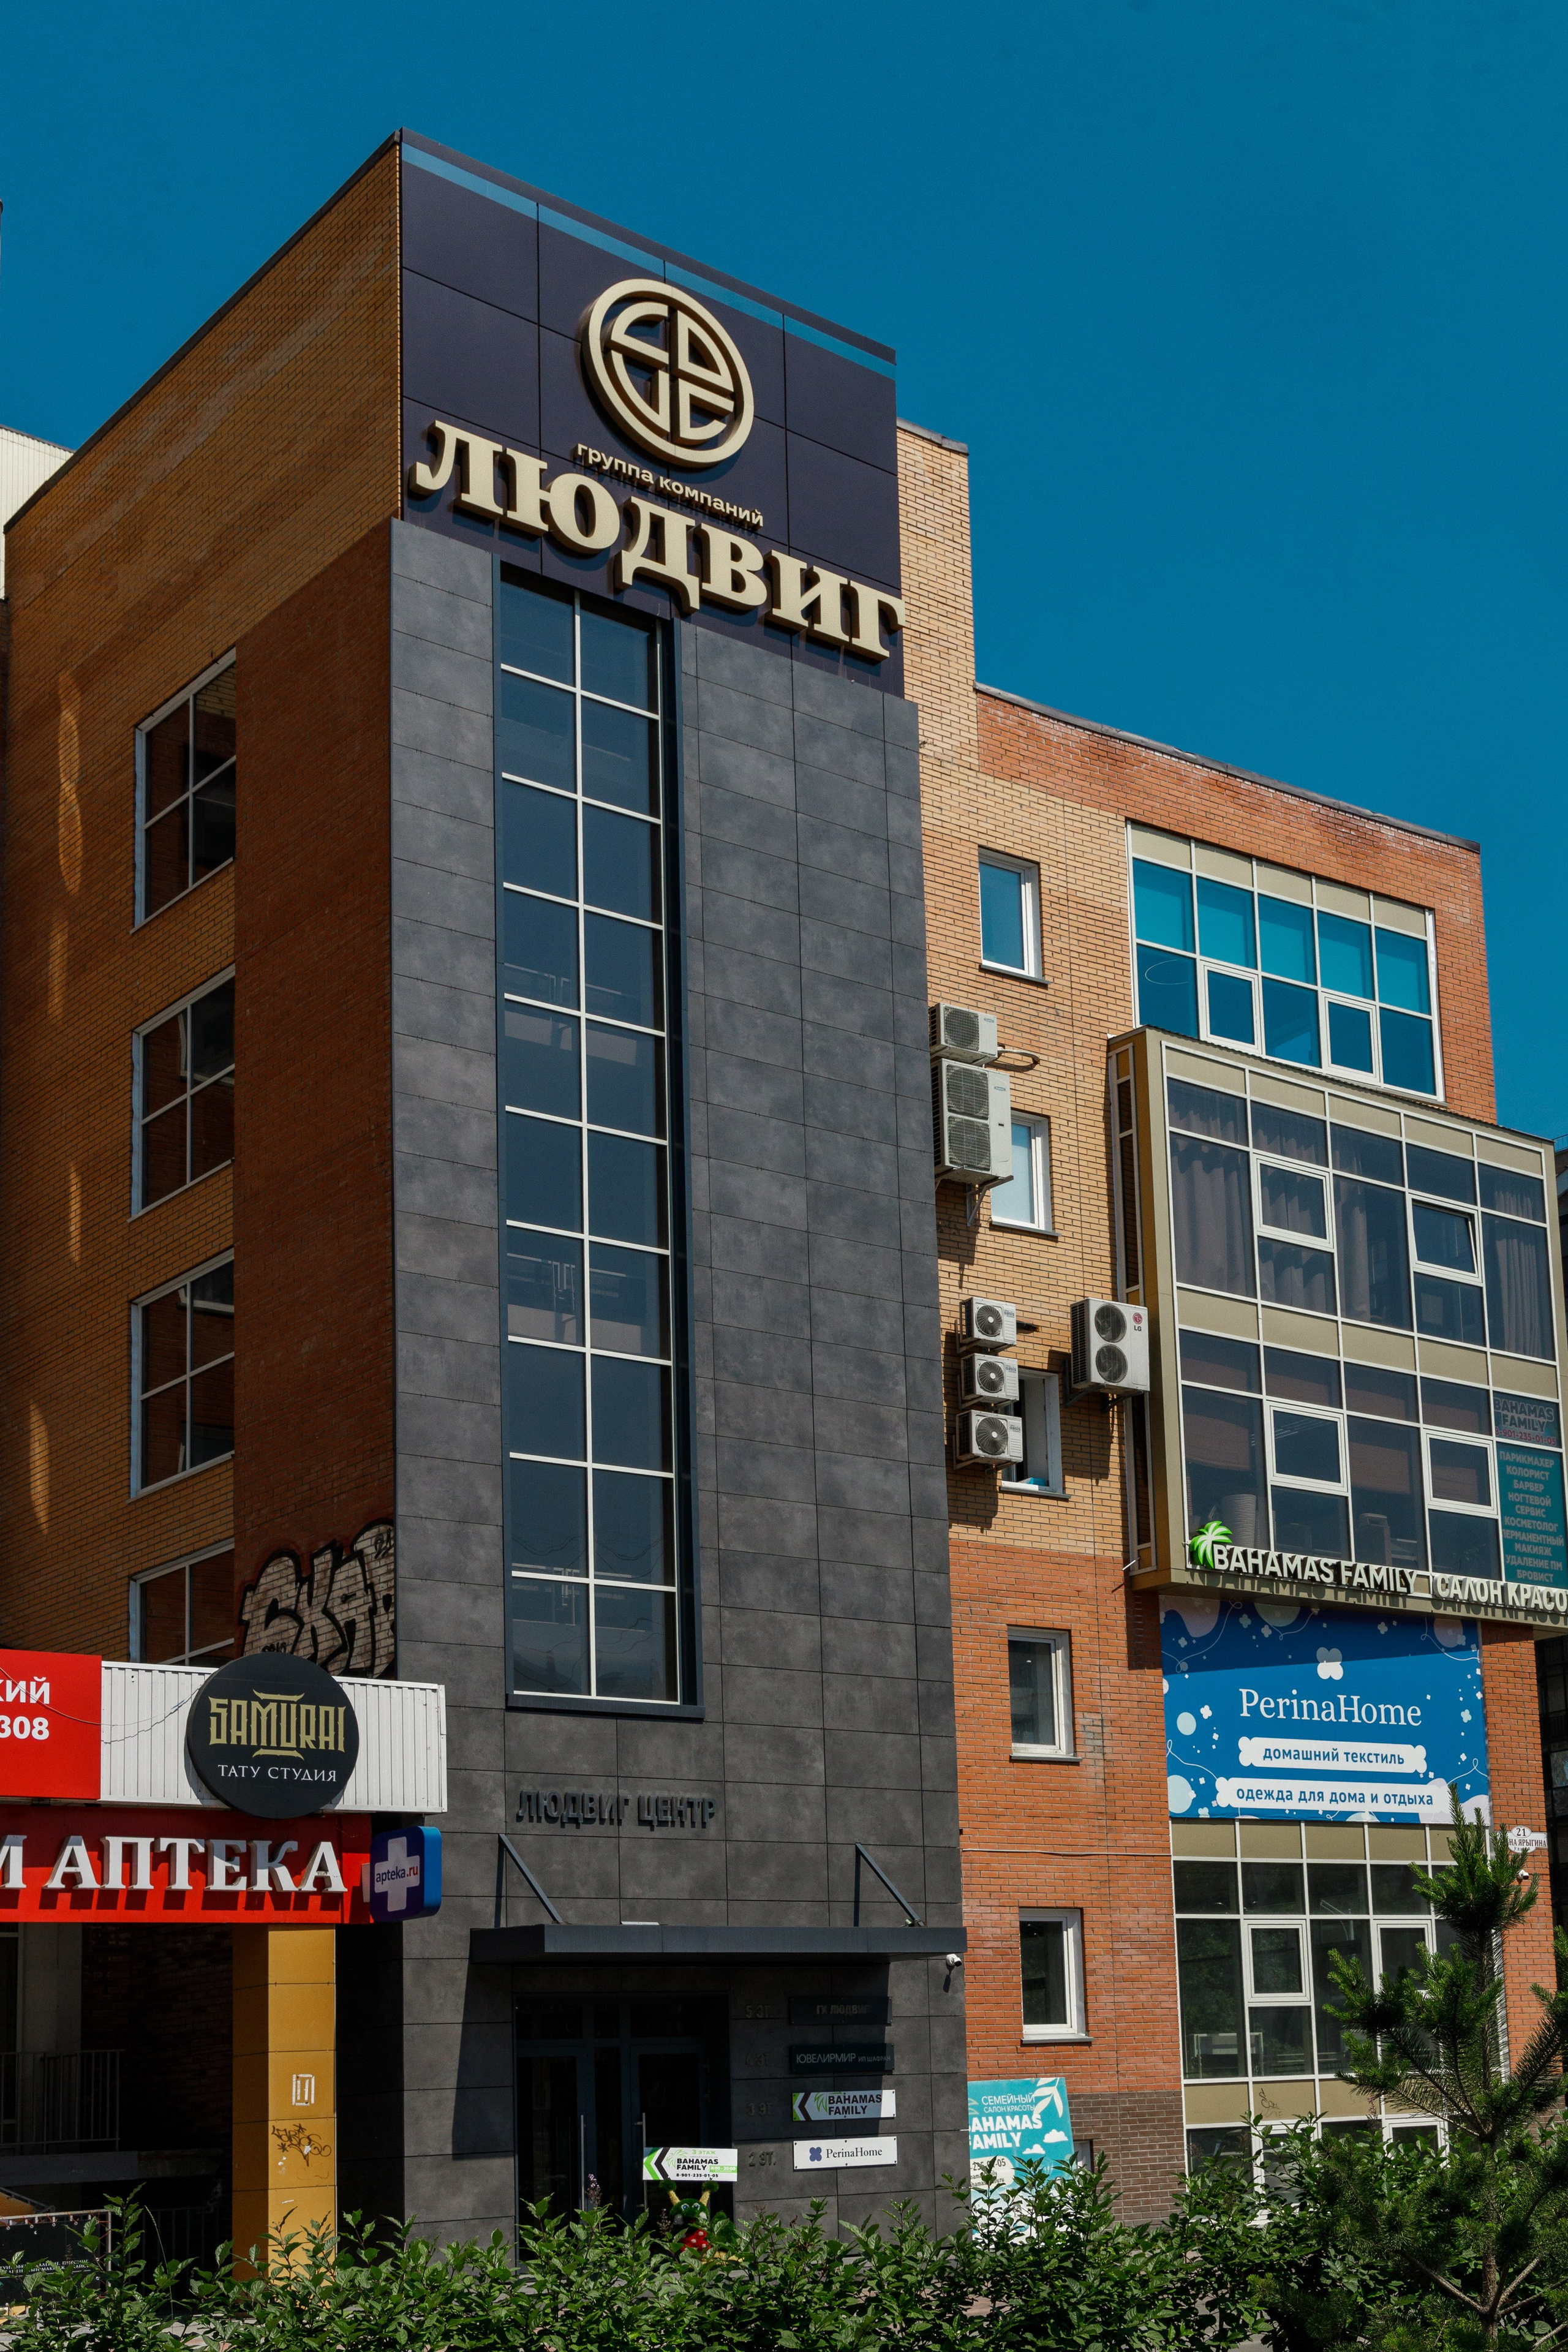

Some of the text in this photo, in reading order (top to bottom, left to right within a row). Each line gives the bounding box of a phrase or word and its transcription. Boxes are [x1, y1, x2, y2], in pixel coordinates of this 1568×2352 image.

[576, 443, 763, 527] группа компаний
[412, 420, 905, 660] ЛЮДВИГ
[1493, 1397, 1555, 1422] BAHAMAS
[1501, 1412, 1547, 1433] FAMILY
[1499, 1450, 1555, 1468] ПАРИКМАХЕР
[1506, 1464, 1550, 1480] КОЛОРИСТ
[1513, 1479, 1545, 1493] БАРБЕР
[1507, 1491, 1551, 1507] НОГТЕВОЙ
[1515, 1504, 1547, 1518] СЕРВИС
[1504, 1516, 1558, 1532] КОСМЕТОЛОГ
[1502, 1528, 1564, 1547] ПЕРМАНЕНТНЫЙ
[1514, 1542, 1552, 1556] МАКИЯЖ
[1213, 1544, 1418, 1594] BAHAMAS FAMILY
[1506, 1555, 1563, 1570] УДАЛЕНИЕ ПМ
[1517, 1569, 1554, 1583] БРОВИСТ
[1434, 1574, 1568, 1613] САЛОН КРАСО
[0, 1676, 50, 1705] ИЙ
[1238, 1688, 1422, 1726] PerinaHome
[1262, 1747, 1404, 1765] домашний текстиль
[217, 1764, 337, 1782] ТАТУ СТУДИЯ
[1236, 1788, 1433, 1806] одежда для дома и отдыха
[517, 1790, 717, 1826] ЛЮДВИГ ЦЕНТР
[1516, 1828, 1526, 1836] 21
[43, 1835, 348, 1894] АПТЕКА
[375, 1866, 418, 1885] apteka.ru
[829, 2005, 870, 2016] ЛЮДВИГ
[796, 2052, 856, 2064] ЮВЕЛИРМИР
[828, 2094, 882, 2105] BAHAMAS
[981, 2092, 1035, 2105] СЕМЕЙНЫЙ
[828, 2105, 867, 2116] FAMILY
[969, 2114, 1042, 2133] AHAMAS
[969, 2132, 1022, 2150] AMILY
[826, 2147, 883, 2158] PerinaHome
